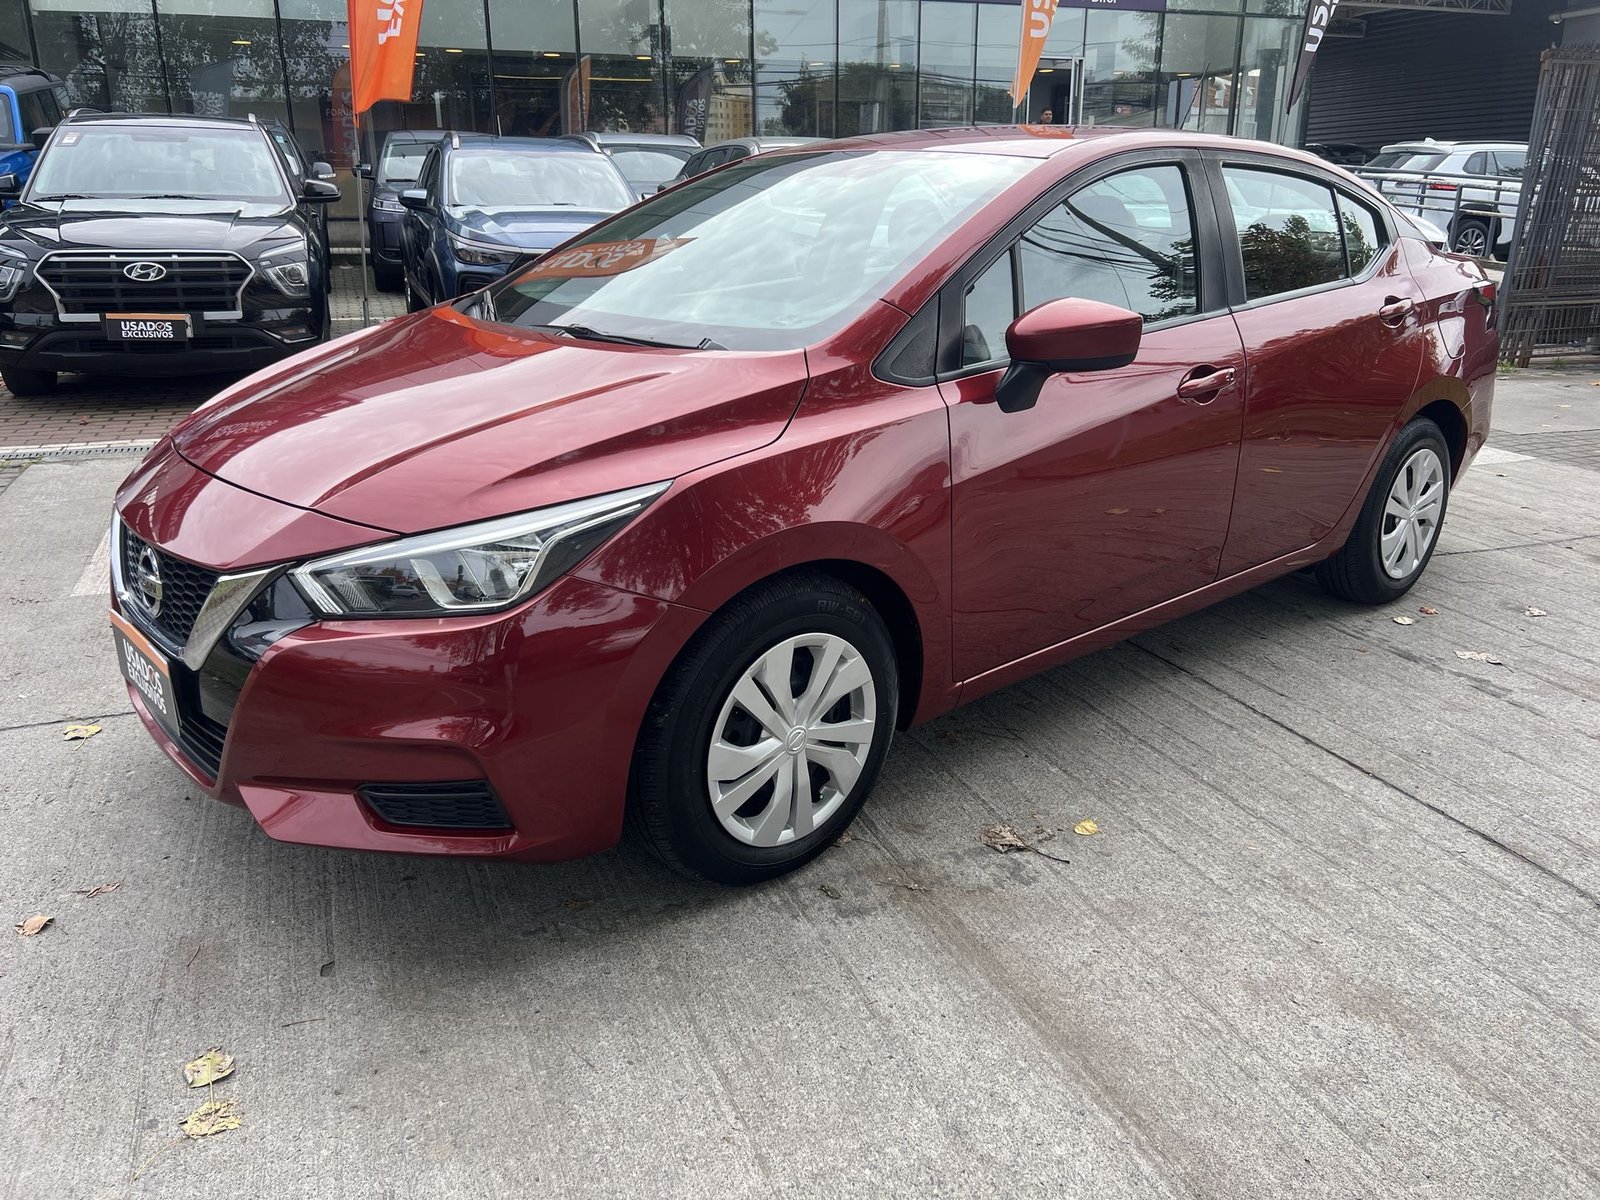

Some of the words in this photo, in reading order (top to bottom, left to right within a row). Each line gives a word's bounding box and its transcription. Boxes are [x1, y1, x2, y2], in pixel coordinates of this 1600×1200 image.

[121, 321, 173, 332] USADOS
[122, 638, 163, 696] USADOS
[127, 663, 167, 715] EXCLUSIVOS
